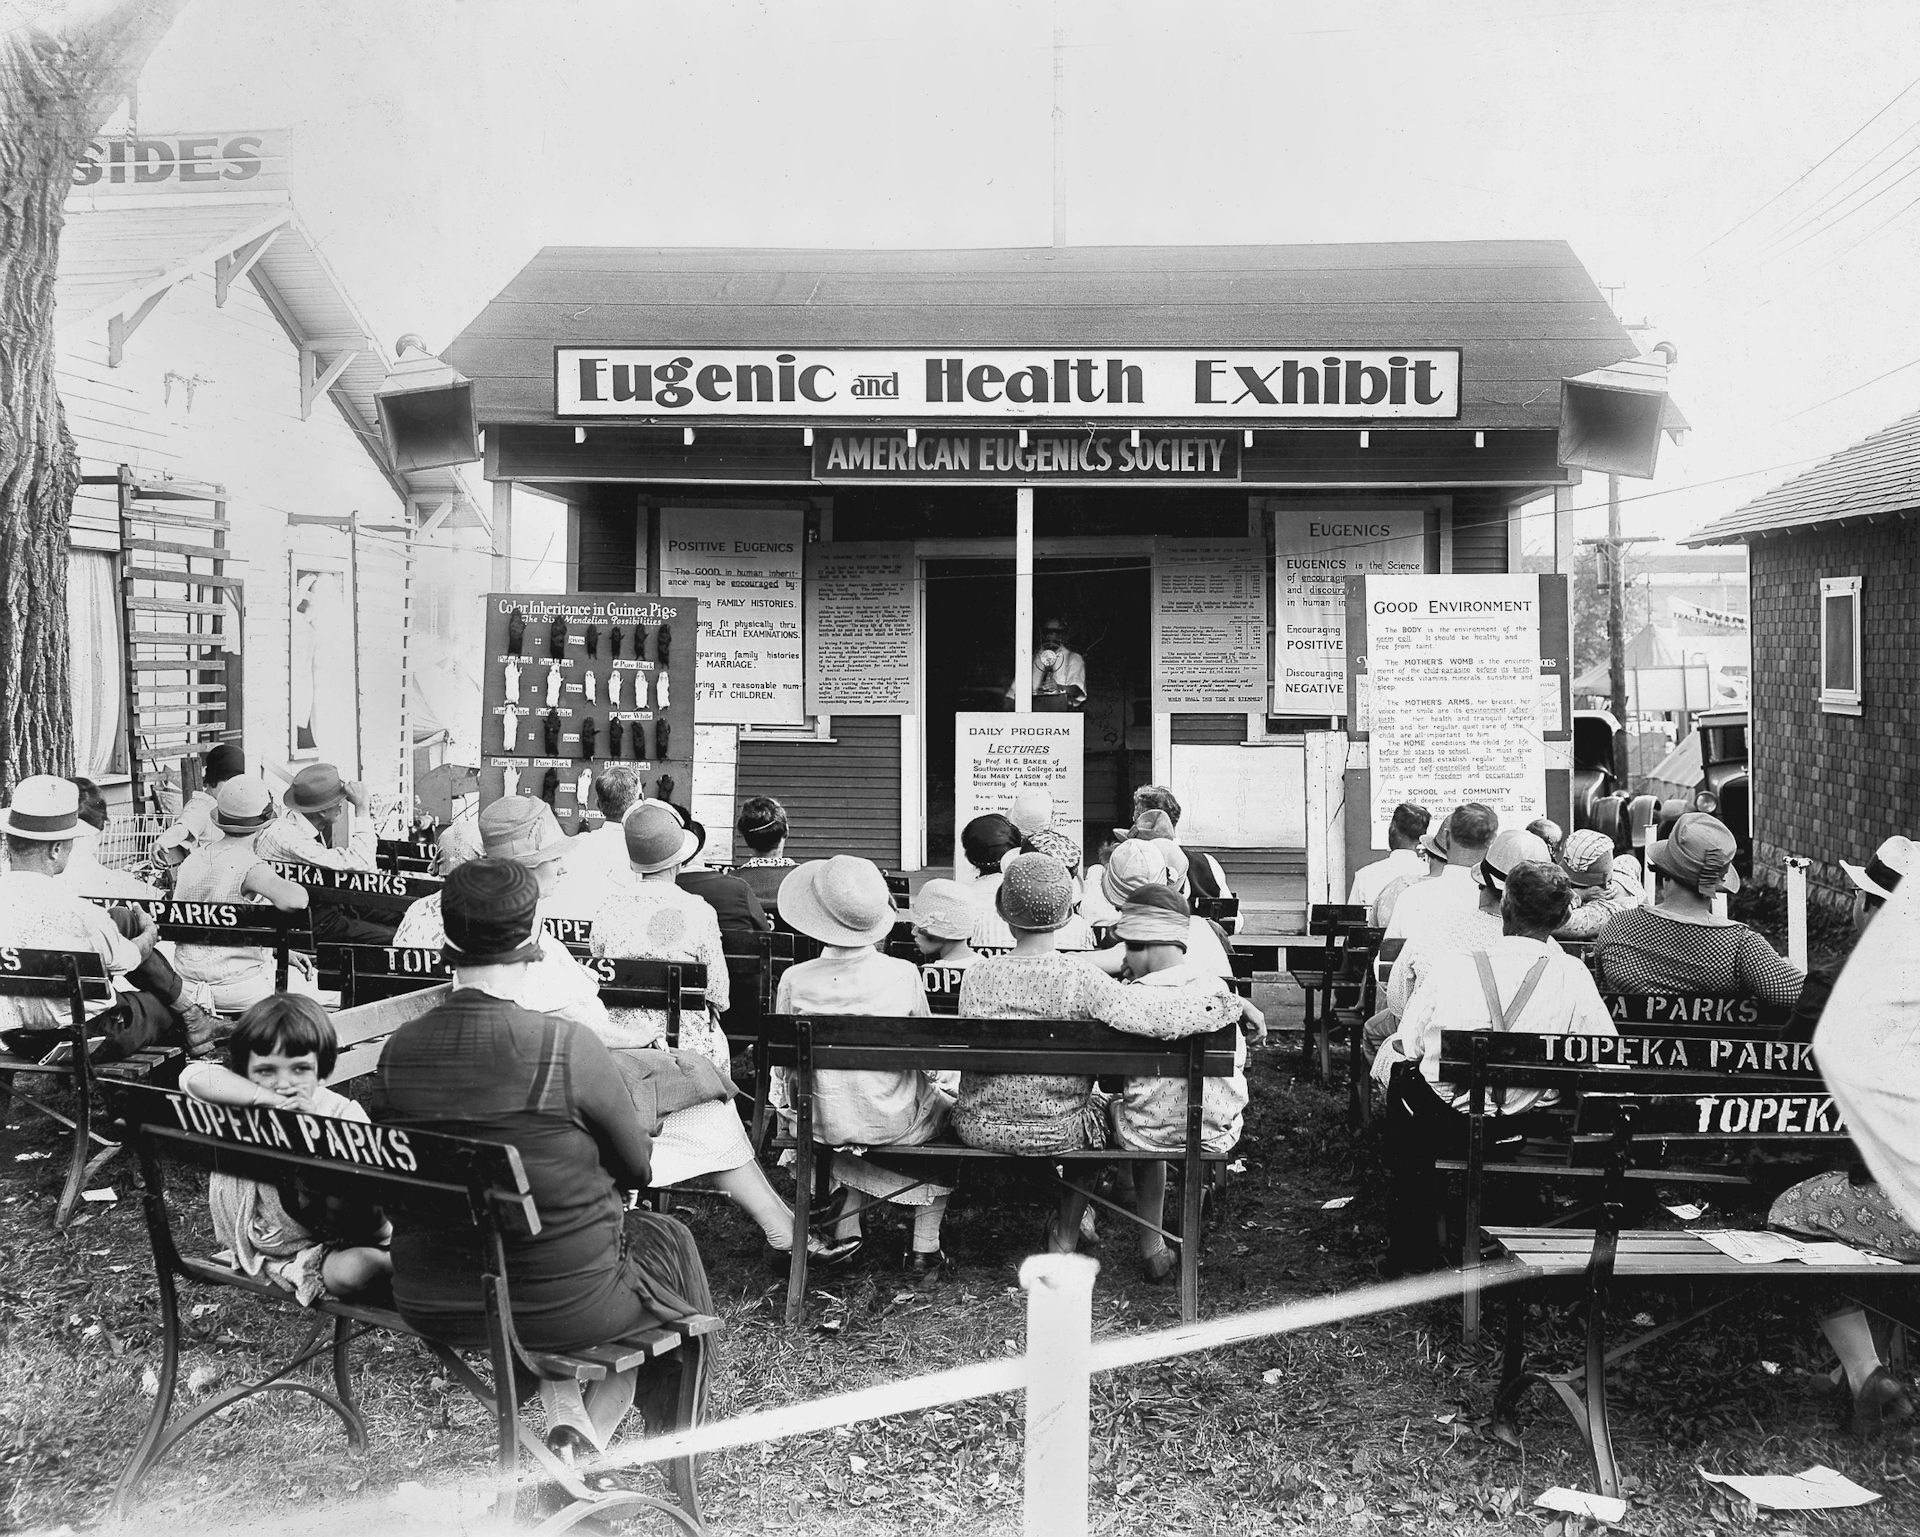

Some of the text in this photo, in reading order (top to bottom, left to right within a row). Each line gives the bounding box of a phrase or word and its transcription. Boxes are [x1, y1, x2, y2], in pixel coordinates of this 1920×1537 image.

[579, 354, 1443, 409] Eugenic and Health Exhibit
[827, 437, 1226, 472] AMERICAN EUGENICS SOCIETY
[1309, 522, 1390, 537] EUGENICS
[668, 540, 794, 553] POSITIVE EUGENICS
[1286, 559, 1420, 571] EUGENICS is the Science
[675, 568, 691, 576] The
[695, 568, 720, 576] GOOD
[737, 569, 763, 578] human
[768, 570, 799, 578] inherit-
[693, 579, 711, 589] may
[716, 578, 726, 587] be
[731, 580, 779, 589] encouraged
[1286, 573, 1346, 584] of encouragi
[1287, 584, 1302, 593] and
[716, 599, 797, 608] FAMILY HISTORIES.
[1287, 597, 1295, 606] in
[1302, 597, 1331, 606] human
[499, 600, 677, 621] Color Inheritance in Guinea Pigs
[1374, 600, 1532, 614] GOOD ENVIRONMENT
[565, 616, 608, 625] Mendelian
[611, 617, 662, 627] Possibilities
[720, 620, 729, 629] fit
[734, 620, 774, 631] physically
[780, 621, 797, 629] thru
[705, 630, 801, 639] HEALTH EXAMINATIONS.
[1286, 625, 1341, 637] Encouraging
[1503, 625, 1510, 634] of
[1475, 634, 1500, 642] healthy
[1287, 640, 1343, 650] POSITIVE
[1376, 643, 1389, 651] free
[1394, 642, 1411, 651] from
[696, 650, 800, 661] paring family histories
[706, 661, 757, 669] MARRIAGE.
[1404, 658, 1443, 666] MOTHER'S
[1286, 669, 1344, 680] Discouraging
[1285, 684, 1344, 693] NEGATIVE
[709, 691, 776, 700] FIT CHILDREN.
[968, 727, 1071, 736] DAILY PROGRAM
[1404, 739, 1425, 747] HOME
[987, 743, 1051, 755] LECTURES
[973, 765, 1022, 773] Southwestern
[1026, 766, 1053, 774] College,
[1045, 773, 1052, 781] of
[1434, 772, 1462, 780] freedom
[973, 780, 1006, 788] University
[1408, 788, 1438, 796] SCHOOL
[273, 861, 407, 897] PEKA PARKS
[150, 900, 238, 927] PARKS
[1646, 995, 1759, 1024] PARKS
[1539, 1034, 1814, 1071] TOPEKA PARK
[166, 1094, 418, 1172] TOPEKA PARKS
